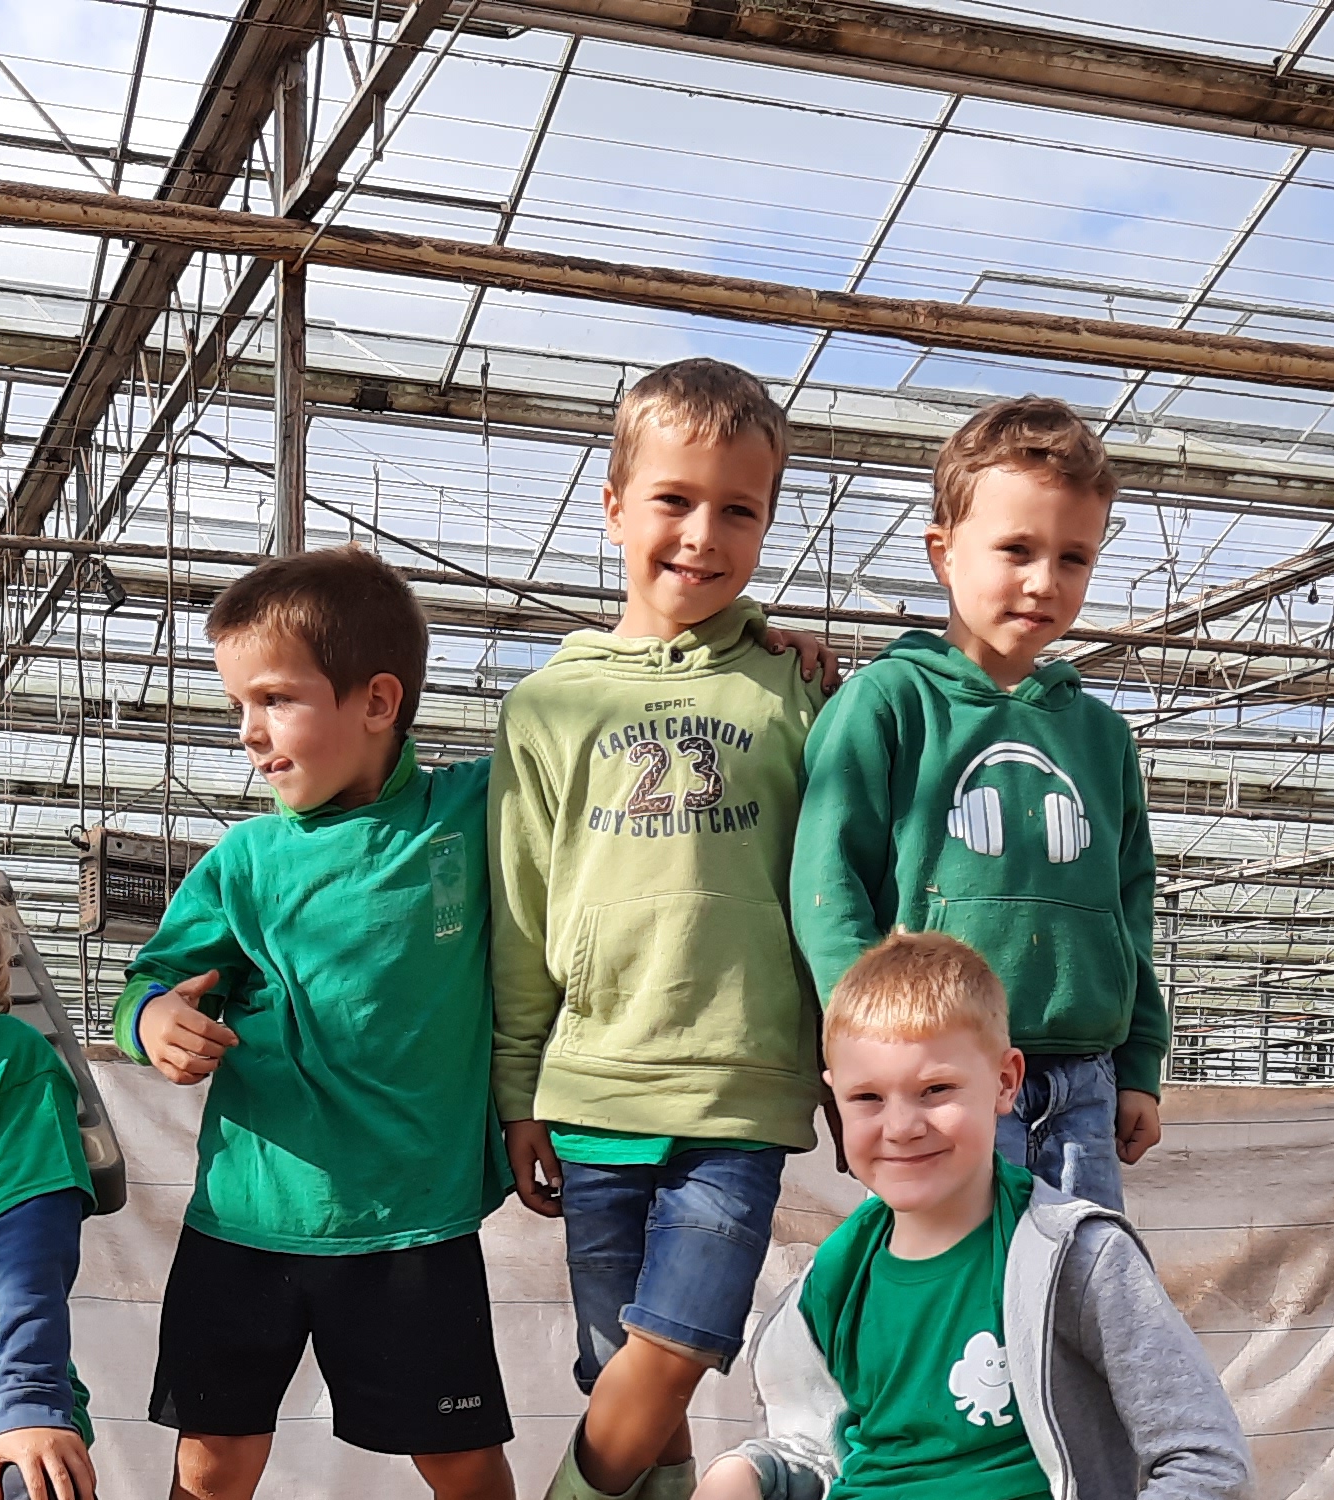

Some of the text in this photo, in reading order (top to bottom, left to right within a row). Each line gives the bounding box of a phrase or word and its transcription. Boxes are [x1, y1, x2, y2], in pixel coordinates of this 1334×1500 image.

[597, 715, 754, 760] EAGLE CANYON
[626, 736, 724, 818] 23
[588, 801, 760, 838] BOY SCOUT CAMP
[455, 1396, 482, 1410] JAKO
